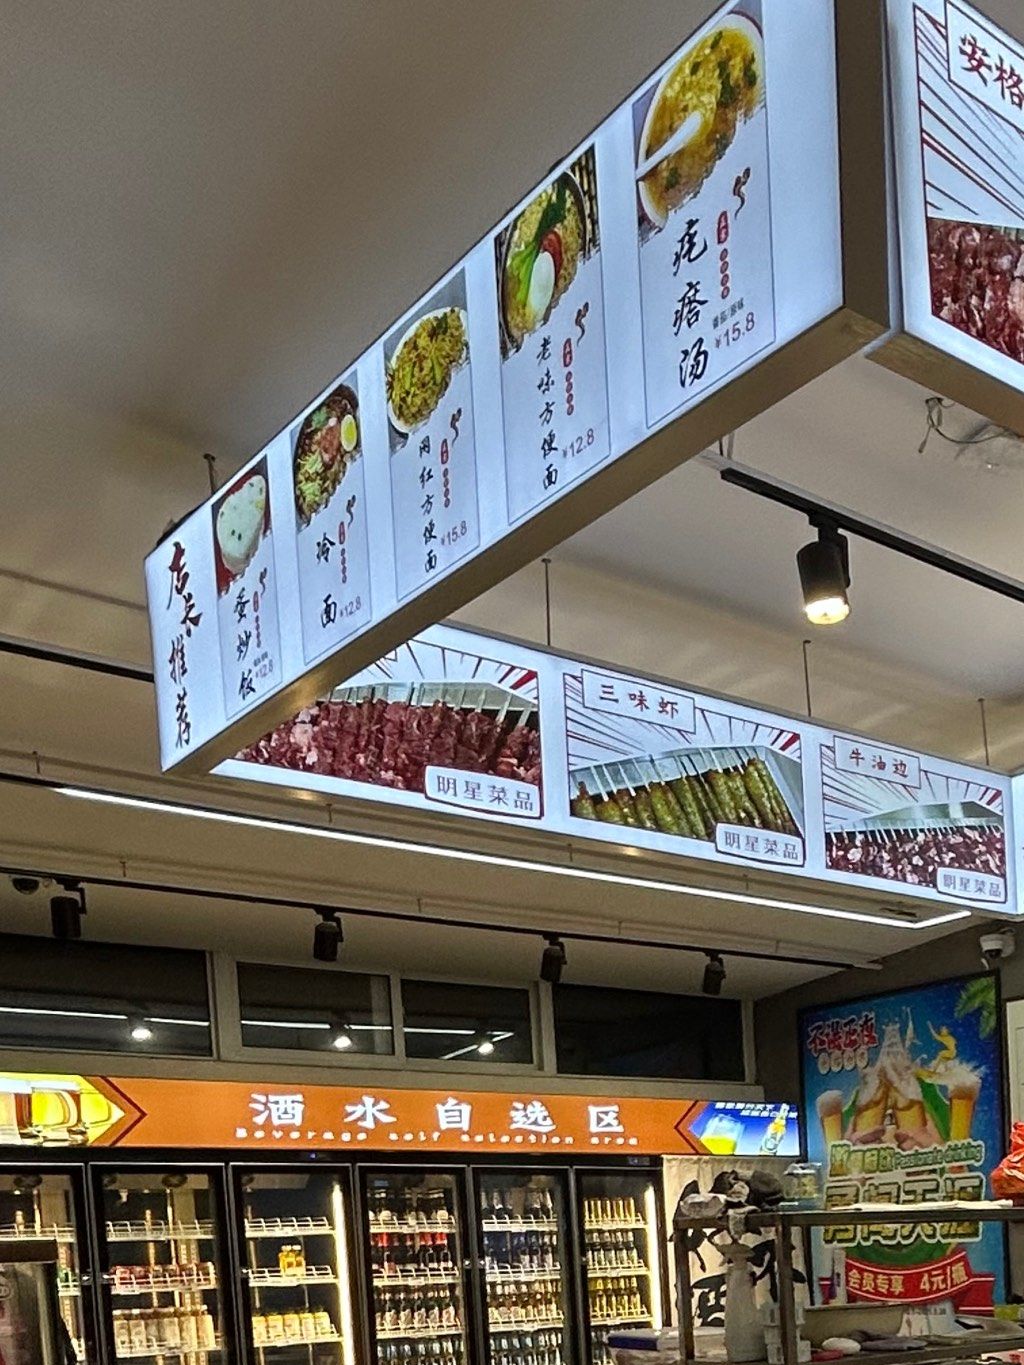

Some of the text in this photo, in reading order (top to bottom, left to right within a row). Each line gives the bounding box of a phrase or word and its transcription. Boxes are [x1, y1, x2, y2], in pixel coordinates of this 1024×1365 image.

[714, 312, 755, 349] ¥15.8
[562, 428, 595, 458] ¥12.8
[418, 435, 438, 573] 网红方便面
[316, 532, 337, 629] 冷面
[233, 587, 256, 700] 蛋炒饭
[598, 683, 680, 719] 三味虾
[848, 748, 908, 779] 牛油边
[436, 773, 535, 813] 明星菜品
[723, 831, 799, 862] 明星菜品
[943, 873, 1001, 897] 明星菜品
[249, 1093, 625, 1133] 酒水自选区
